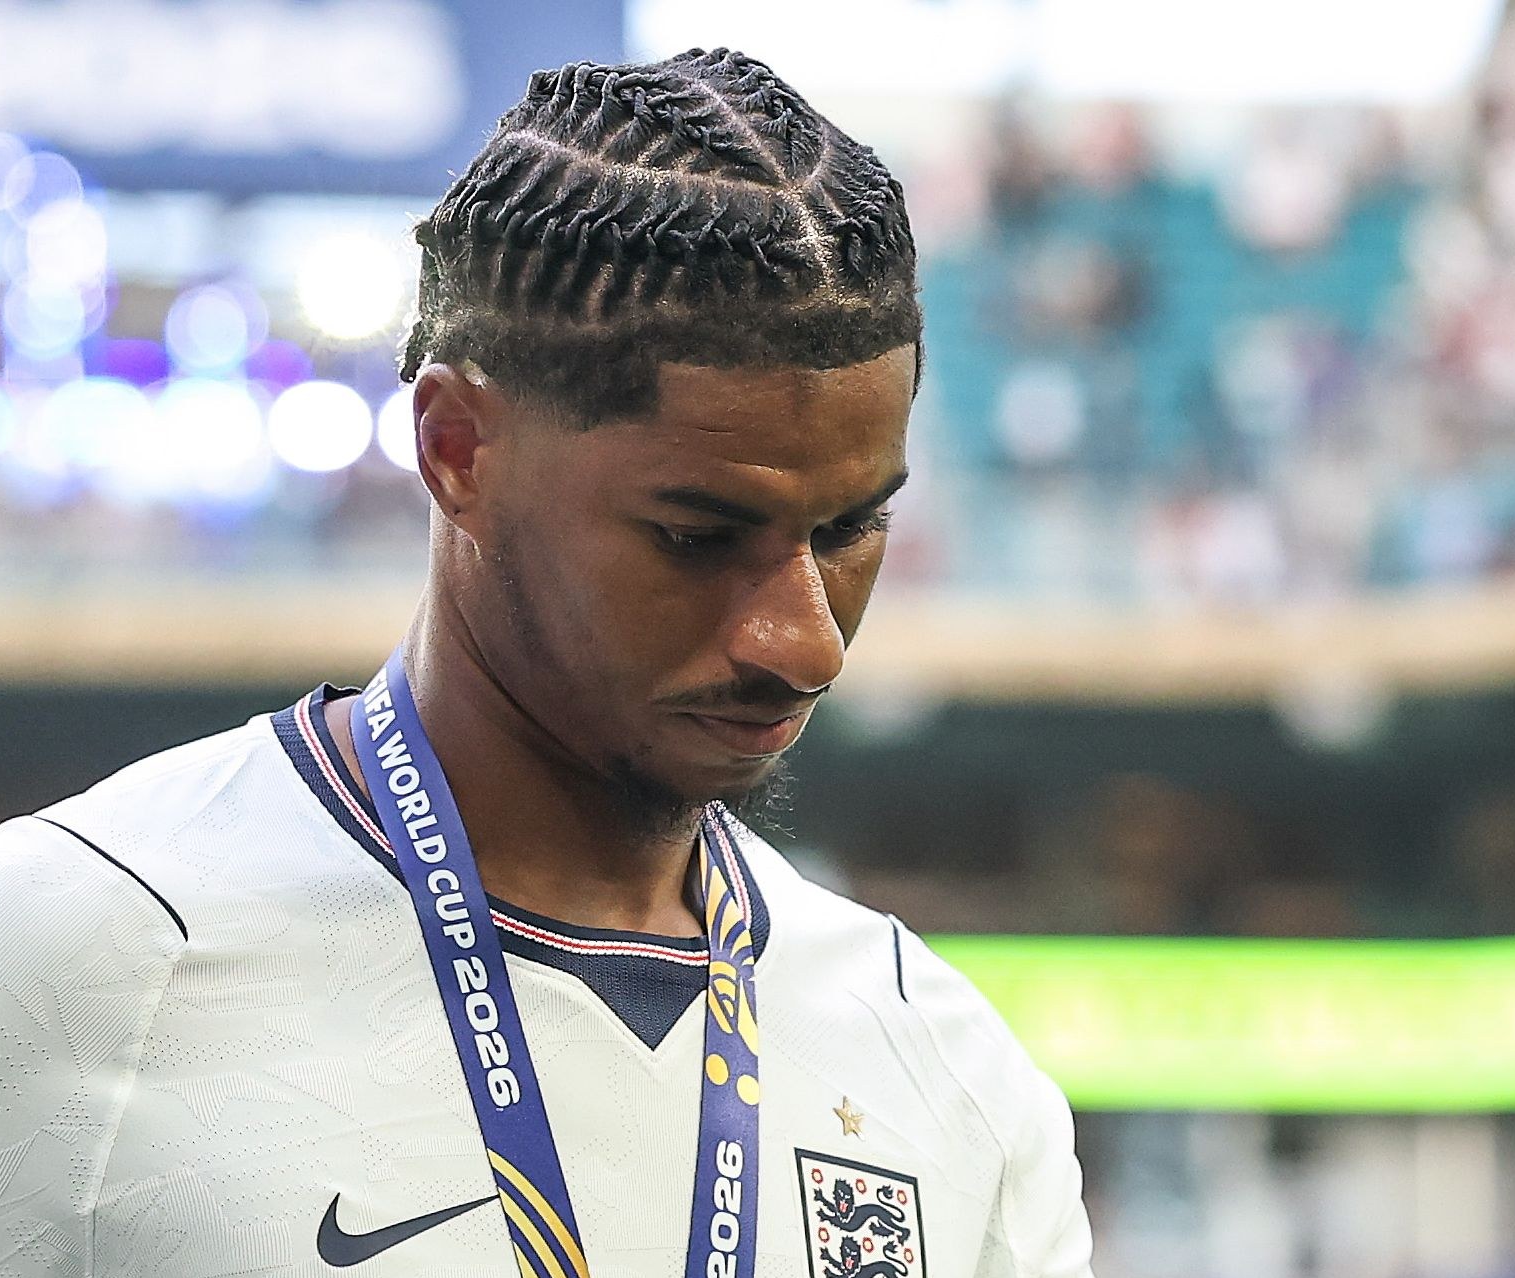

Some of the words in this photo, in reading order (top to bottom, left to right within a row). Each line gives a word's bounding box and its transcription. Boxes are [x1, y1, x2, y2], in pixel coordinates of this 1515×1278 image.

[376, 730, 448, 864] WORLD
[427, 869, 476, 949] CUP
[452, 956, 521, 1108] 2026
